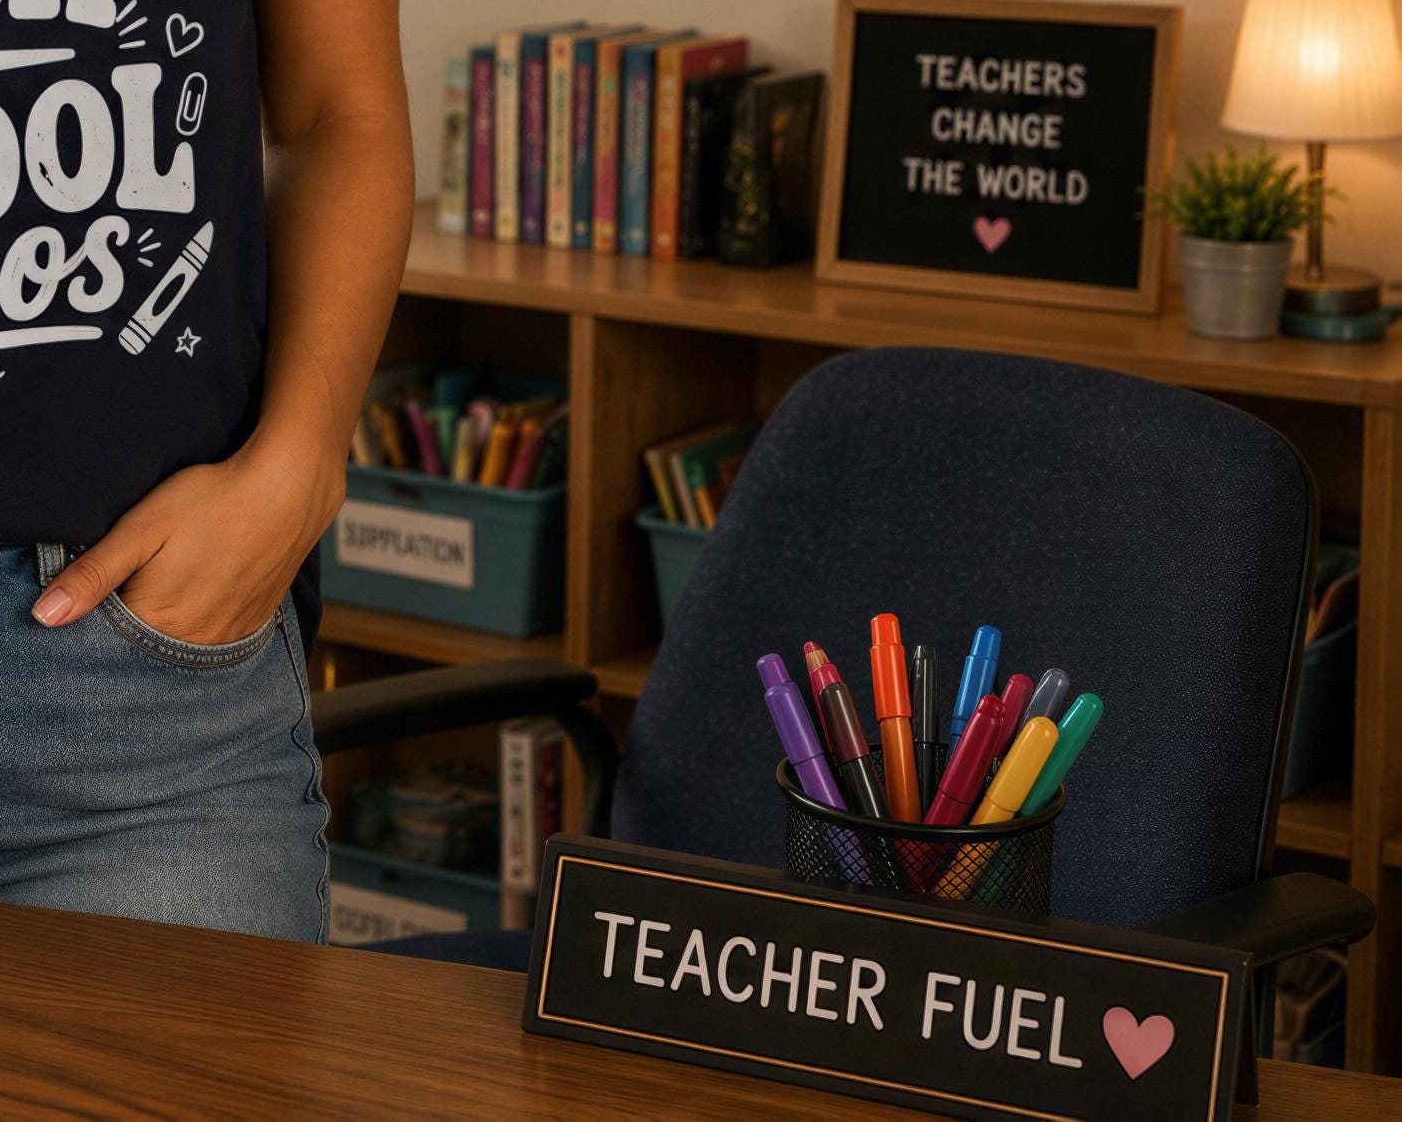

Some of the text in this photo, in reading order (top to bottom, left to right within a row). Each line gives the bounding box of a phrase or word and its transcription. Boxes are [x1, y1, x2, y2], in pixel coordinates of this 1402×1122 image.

[915, 53, 1088, 99] TEACHERS
[930, 106, 1064, 150] CHANGE
[901, 156, 1090, 206] THE WORLD
[594, 911, 1083, 1068] TEACHER FUEL
